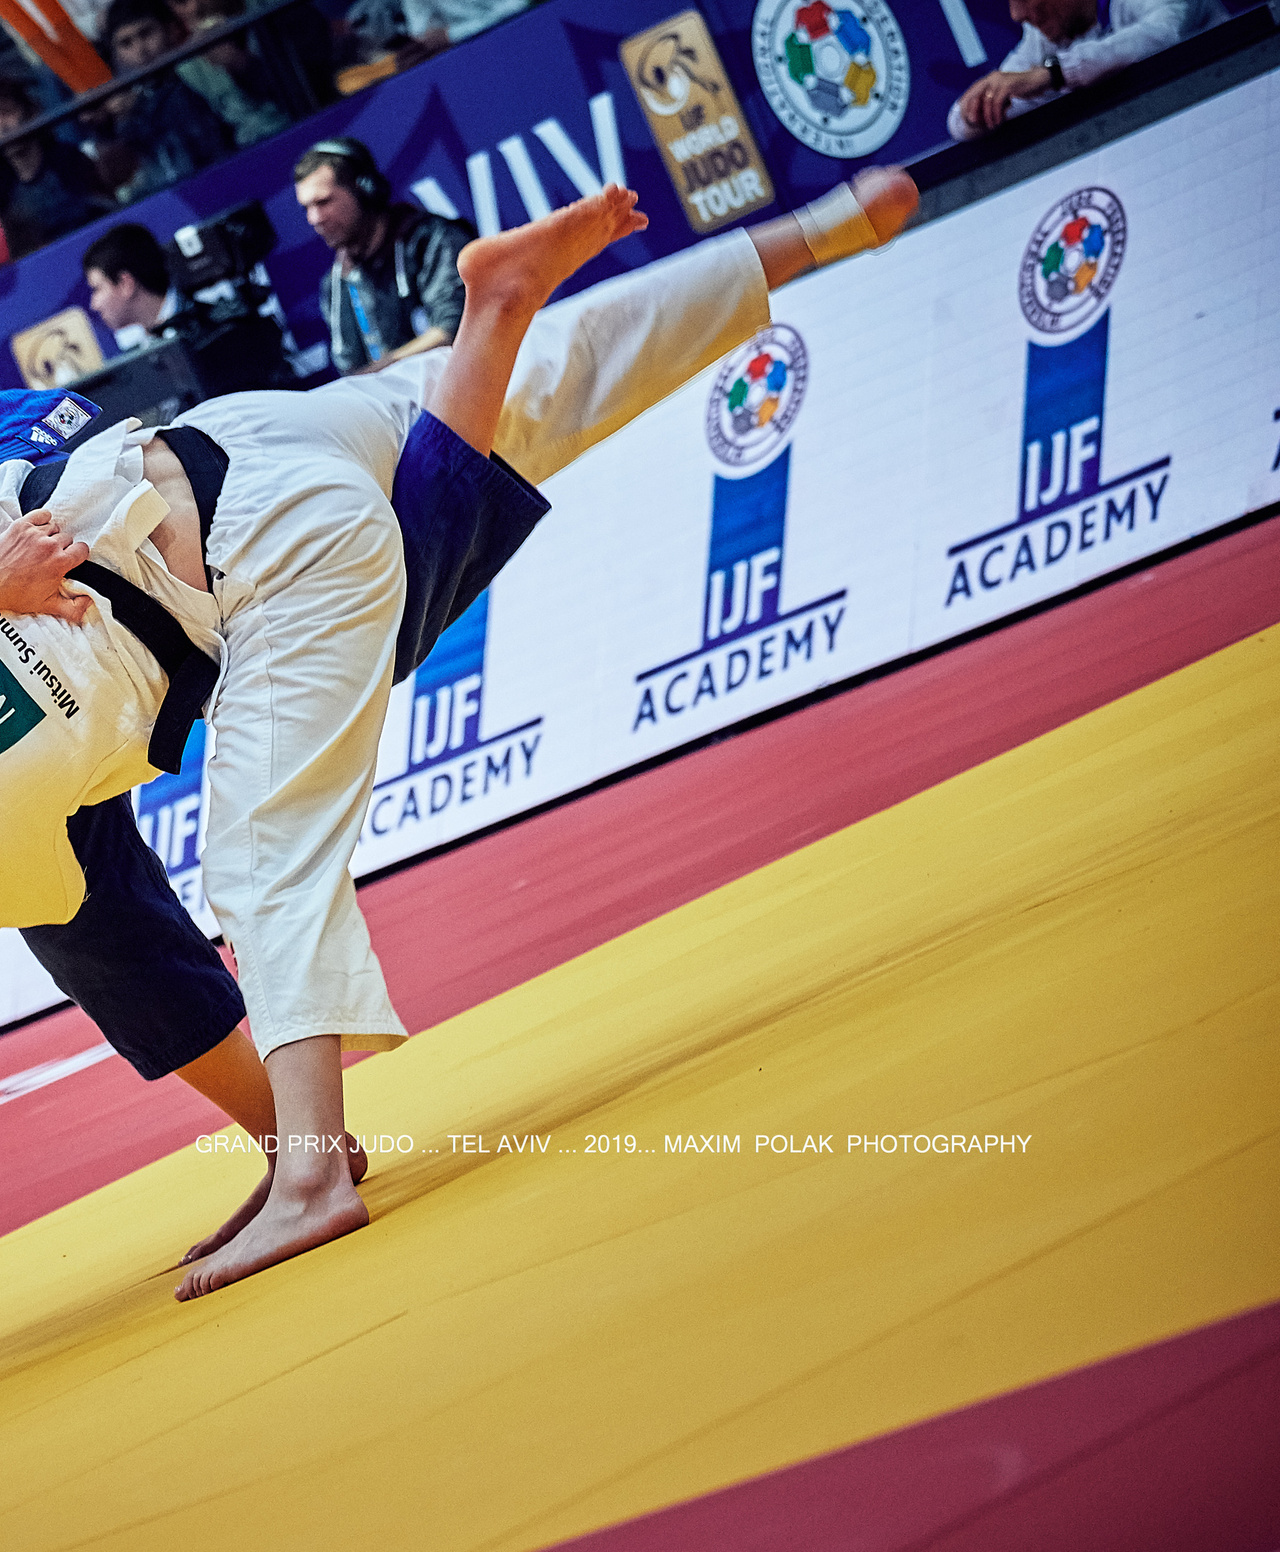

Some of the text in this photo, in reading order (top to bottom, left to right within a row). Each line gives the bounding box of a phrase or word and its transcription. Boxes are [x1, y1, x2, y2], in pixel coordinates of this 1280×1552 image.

[668, 115, 740, 163] WORLD
[682, 140, 750, 194] JUDO
[688, 168, 766, 223] TOUR
[1024, 415, 1101, 512] IJF
[944, 473, 1169, 608] ACADEMY
[707, 545, 781, 642] IJF
[29, 659, 81, 719] Mitsui
[632, 605, 846, 734] ACADEMY
[410, 672, 482, 766] IJF
[357, 733, 542, 845] CADEMY
